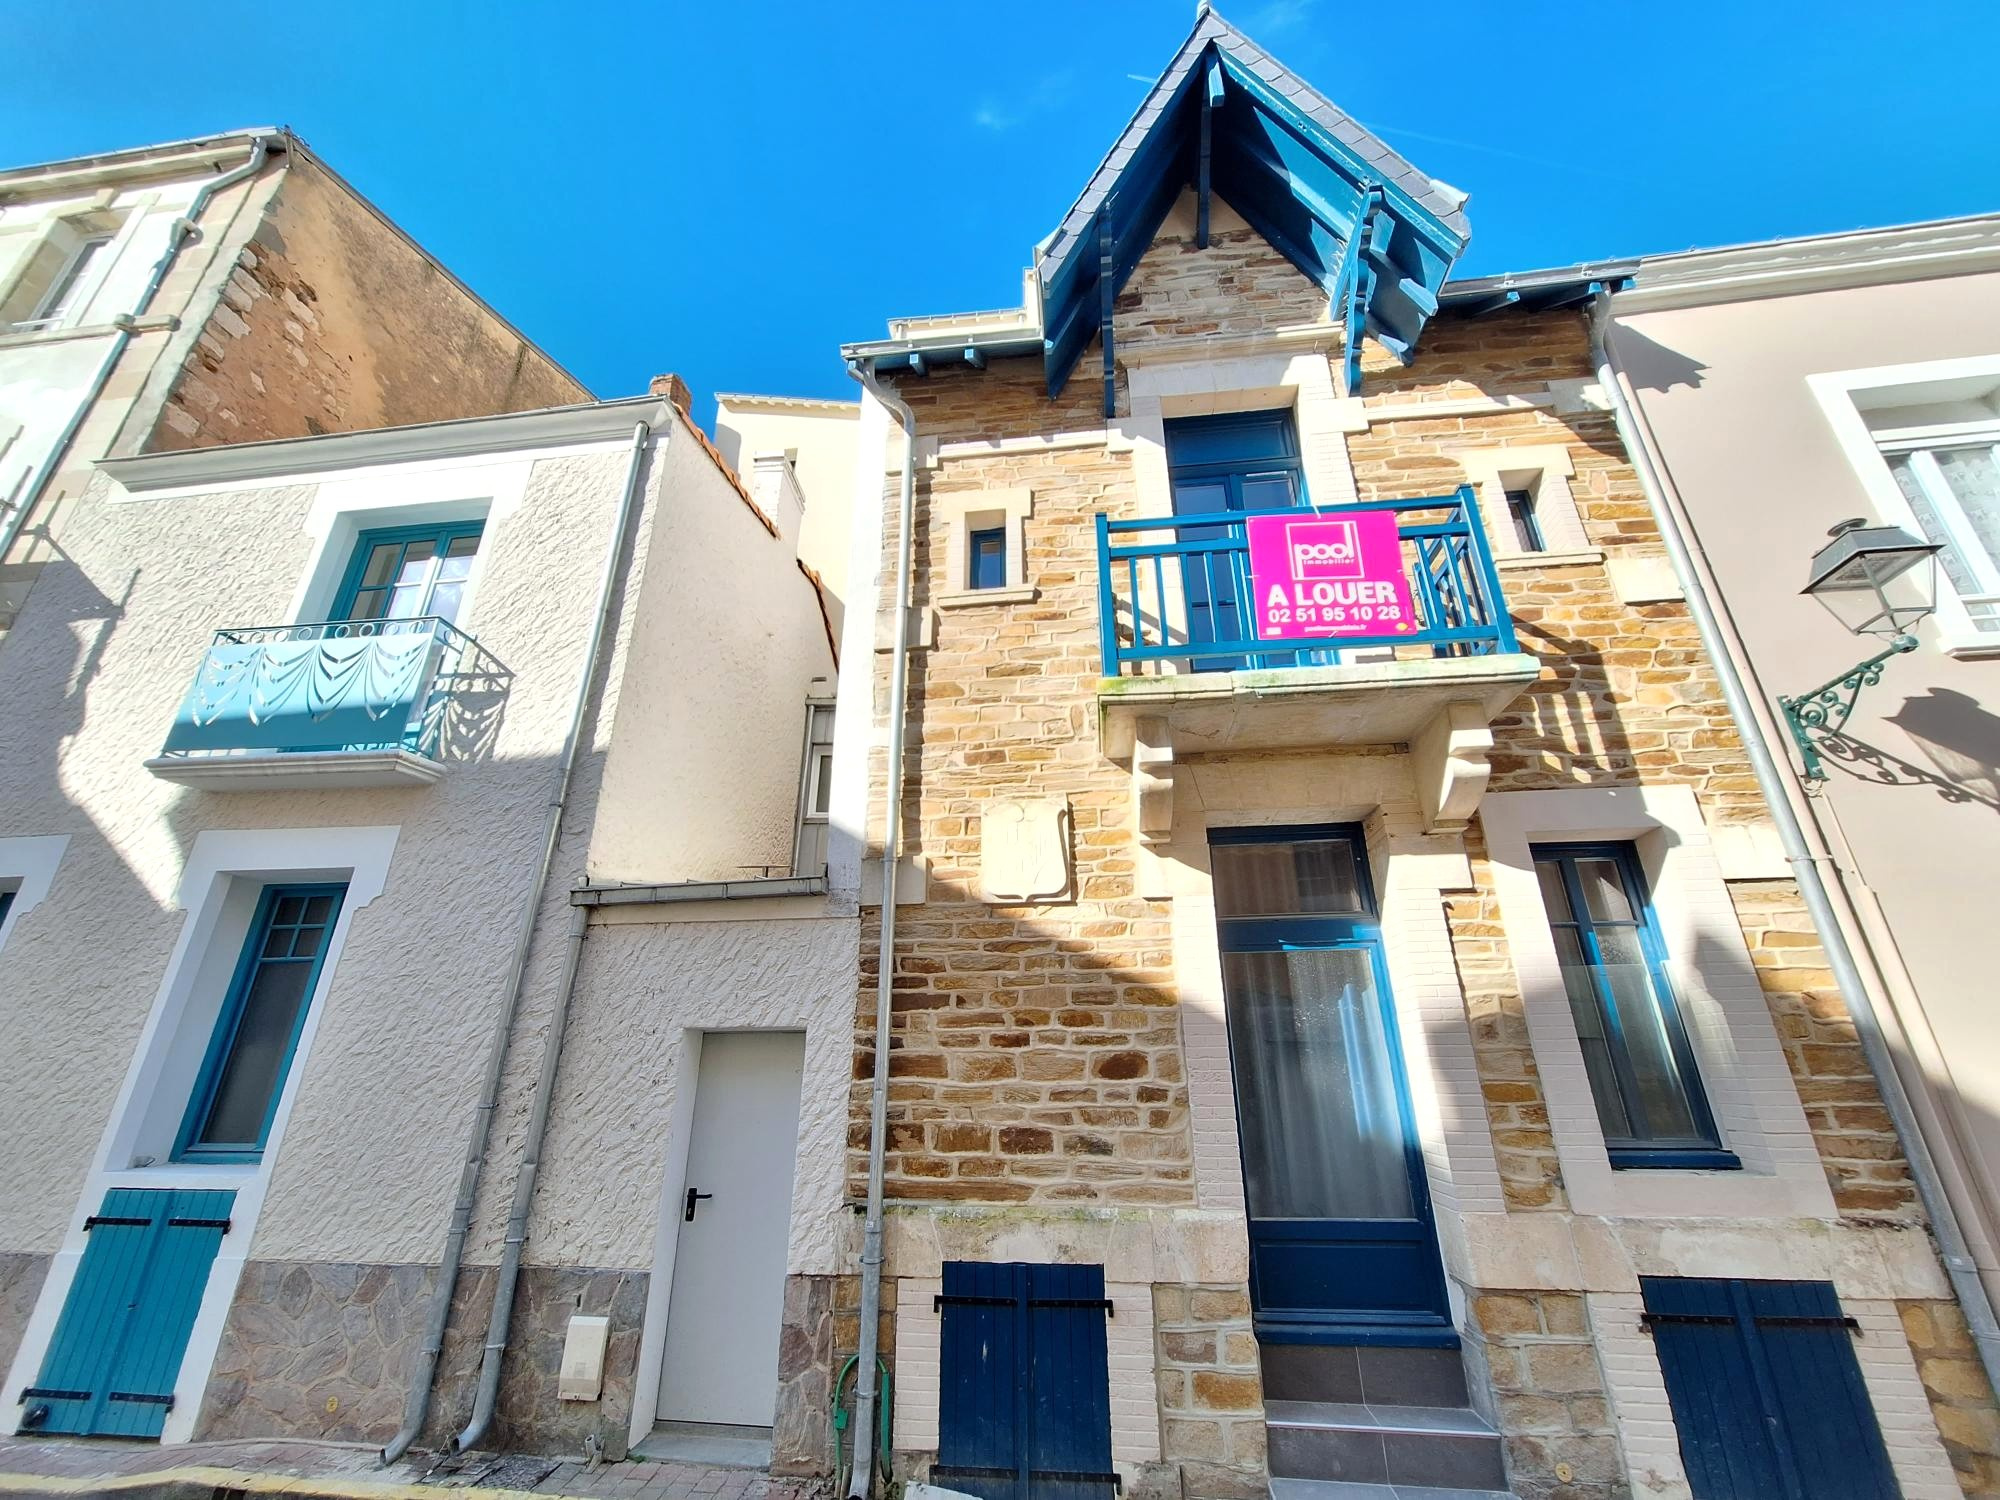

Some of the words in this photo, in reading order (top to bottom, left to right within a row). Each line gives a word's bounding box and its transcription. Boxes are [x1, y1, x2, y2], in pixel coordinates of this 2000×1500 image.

[1294, 522, 1354, 579] pool
[1268, 584, 1289, 607] A
[1295, 581, 1398, 606] LOUER
[1268, 608, 1291, 623] 02
[1296, 607, 1316, 622] 51
[1322, 607, 1345, 621] 95
[1350, 606, 1373, 621] 10
[1377, 605, 1400, 620] 28
